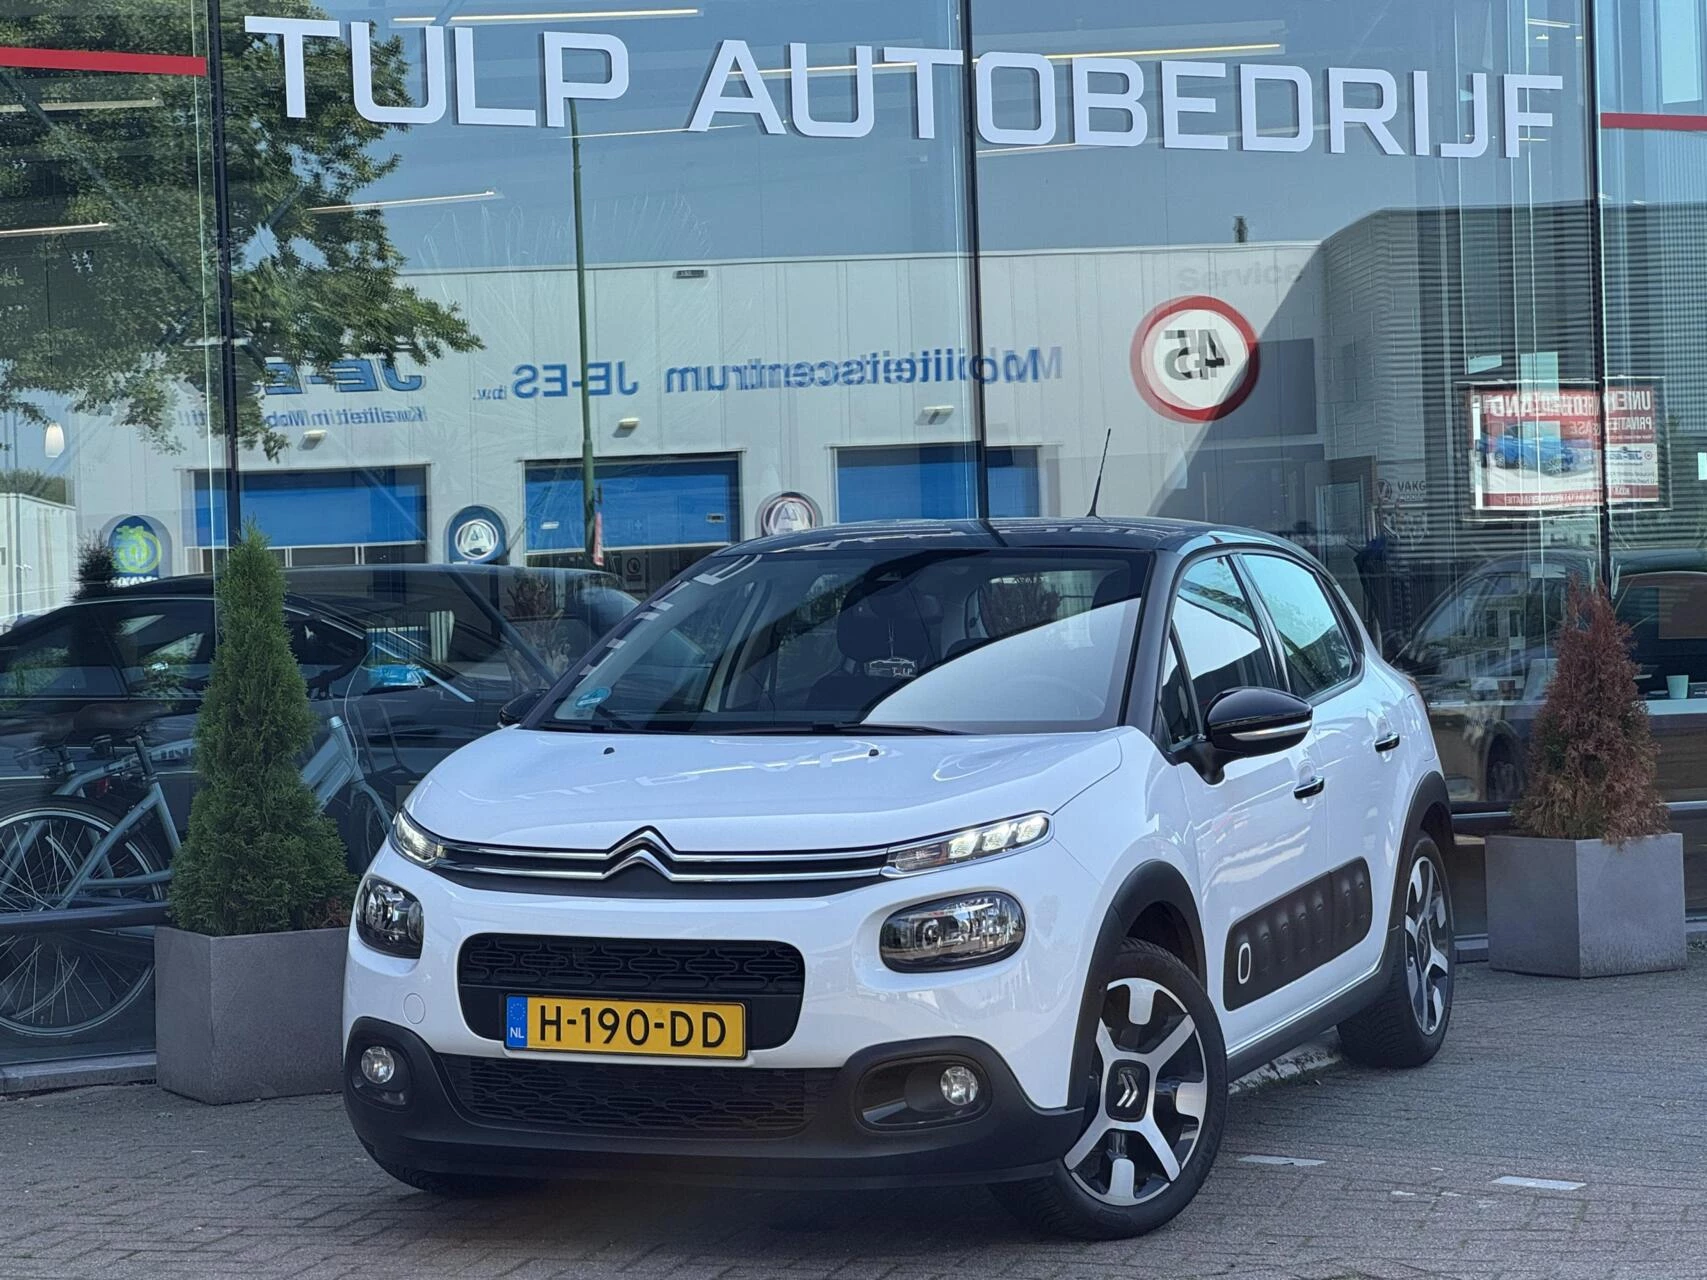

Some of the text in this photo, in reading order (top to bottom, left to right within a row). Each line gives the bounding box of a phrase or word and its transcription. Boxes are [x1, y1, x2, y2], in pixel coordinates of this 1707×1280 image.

[244, 15, 1563, 159] TULP AUTOBEDRIJF
[509, 1005, 727, 1049] NL H-190-DD
